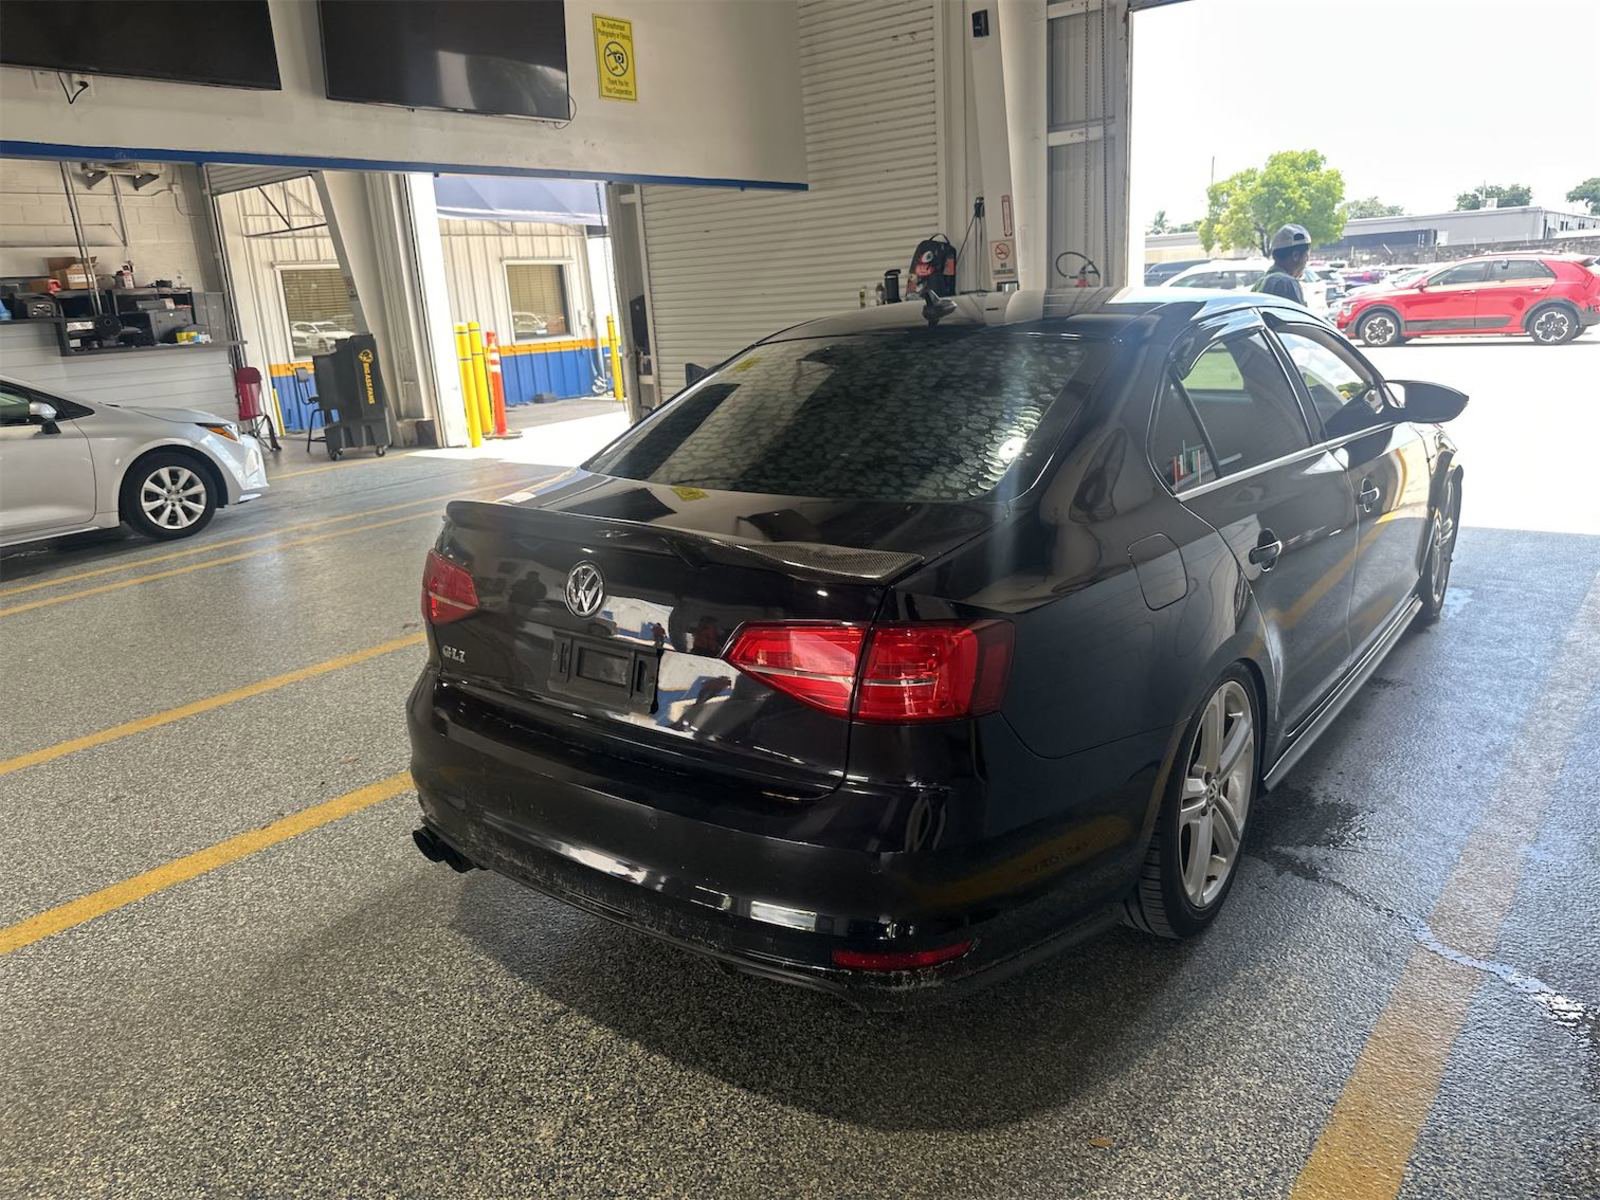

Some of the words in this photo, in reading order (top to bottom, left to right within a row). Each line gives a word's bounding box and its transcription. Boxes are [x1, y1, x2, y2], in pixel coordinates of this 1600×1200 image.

[365, 374, 373, 389] ASS
[367, 388, 376, 405] FANS
[442, 644, 466, 663] GLI
